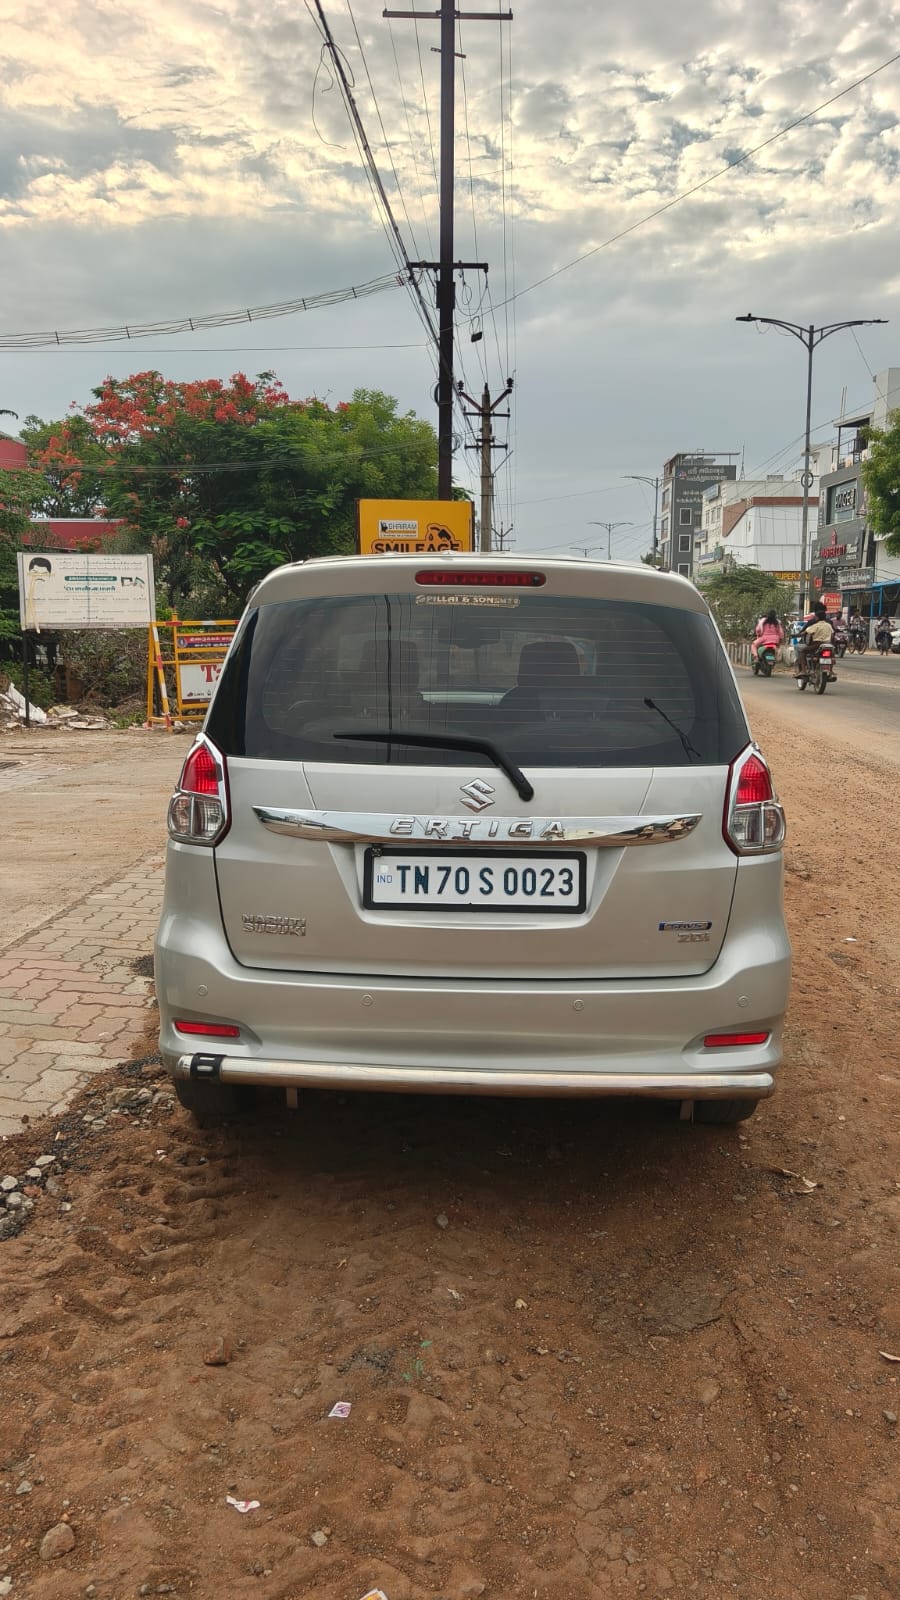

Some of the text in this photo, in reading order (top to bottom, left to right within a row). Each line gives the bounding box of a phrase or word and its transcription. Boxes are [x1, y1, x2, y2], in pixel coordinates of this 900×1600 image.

[390, 817, 565, 838] ERTIGA
[377, 875, 393, 884] IND
[479, 867, 494, 896] S
[503, 867, 574, 897] 0023
[242, 913, 306, 926] MARUTI
[242, 923, 306, 937] SUZUKI
